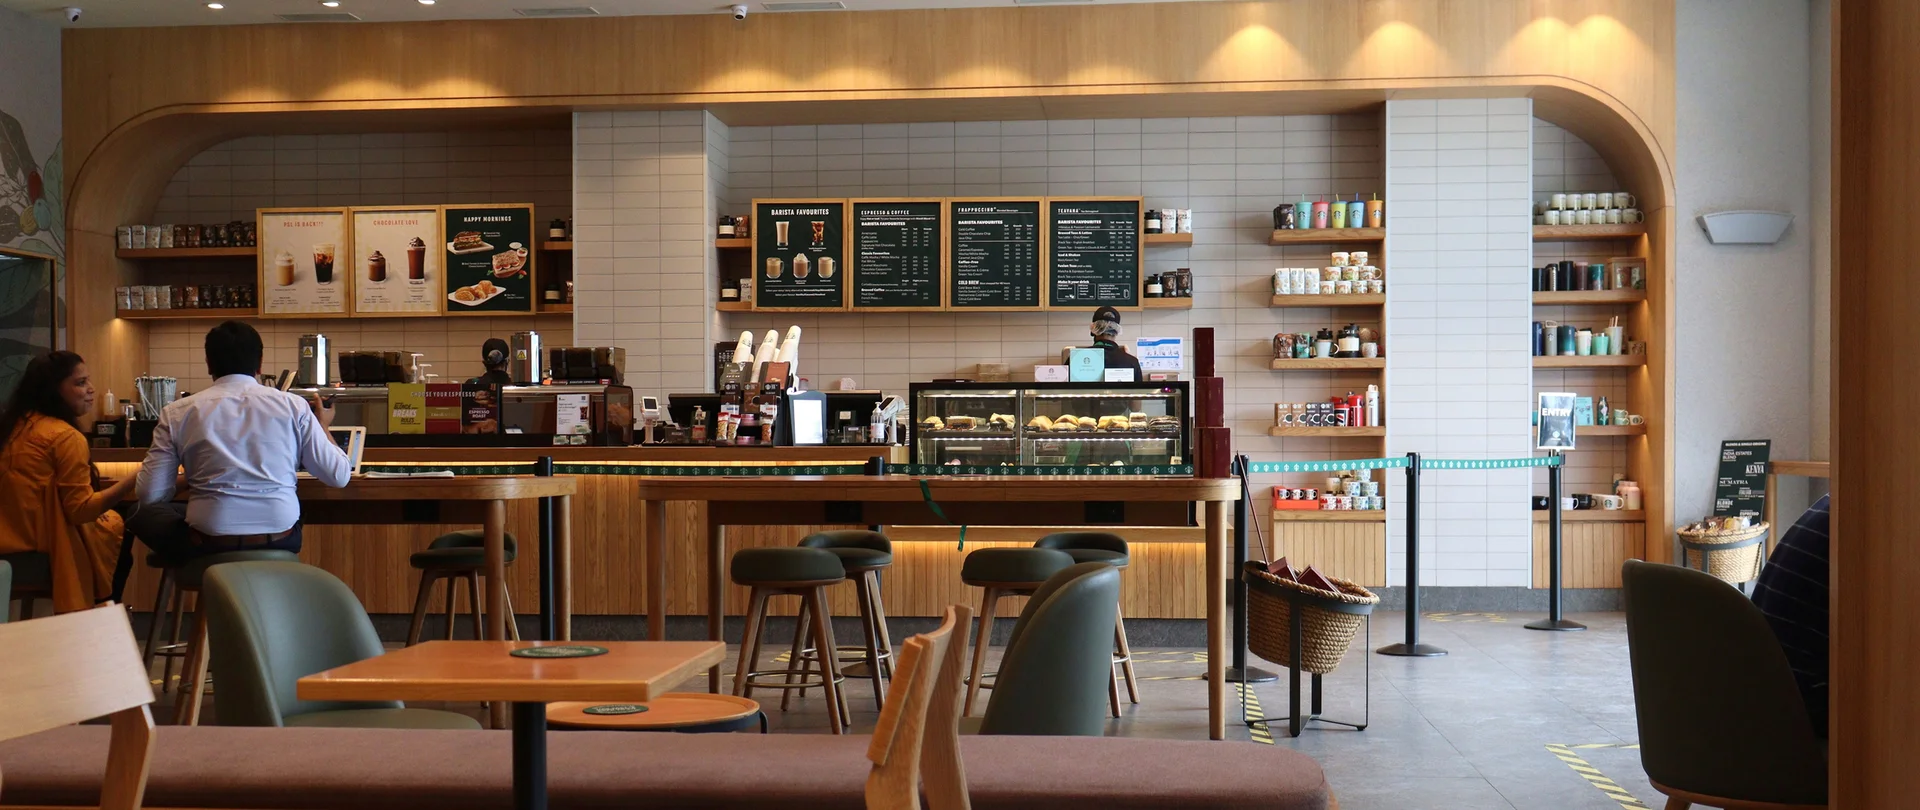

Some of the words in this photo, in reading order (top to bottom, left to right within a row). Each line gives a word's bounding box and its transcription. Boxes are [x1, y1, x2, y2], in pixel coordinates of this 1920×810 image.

[771, 208, 794, 216] BARISTA
[796, 208, 829, 216] FAVOURITES
[283, 220, 294, 228] PSL
[392, 409, 417, 418] BREAKS
[1542, 407, 1571, 417] ENTRY
[1746, 464, 1764, 474] KENYA
